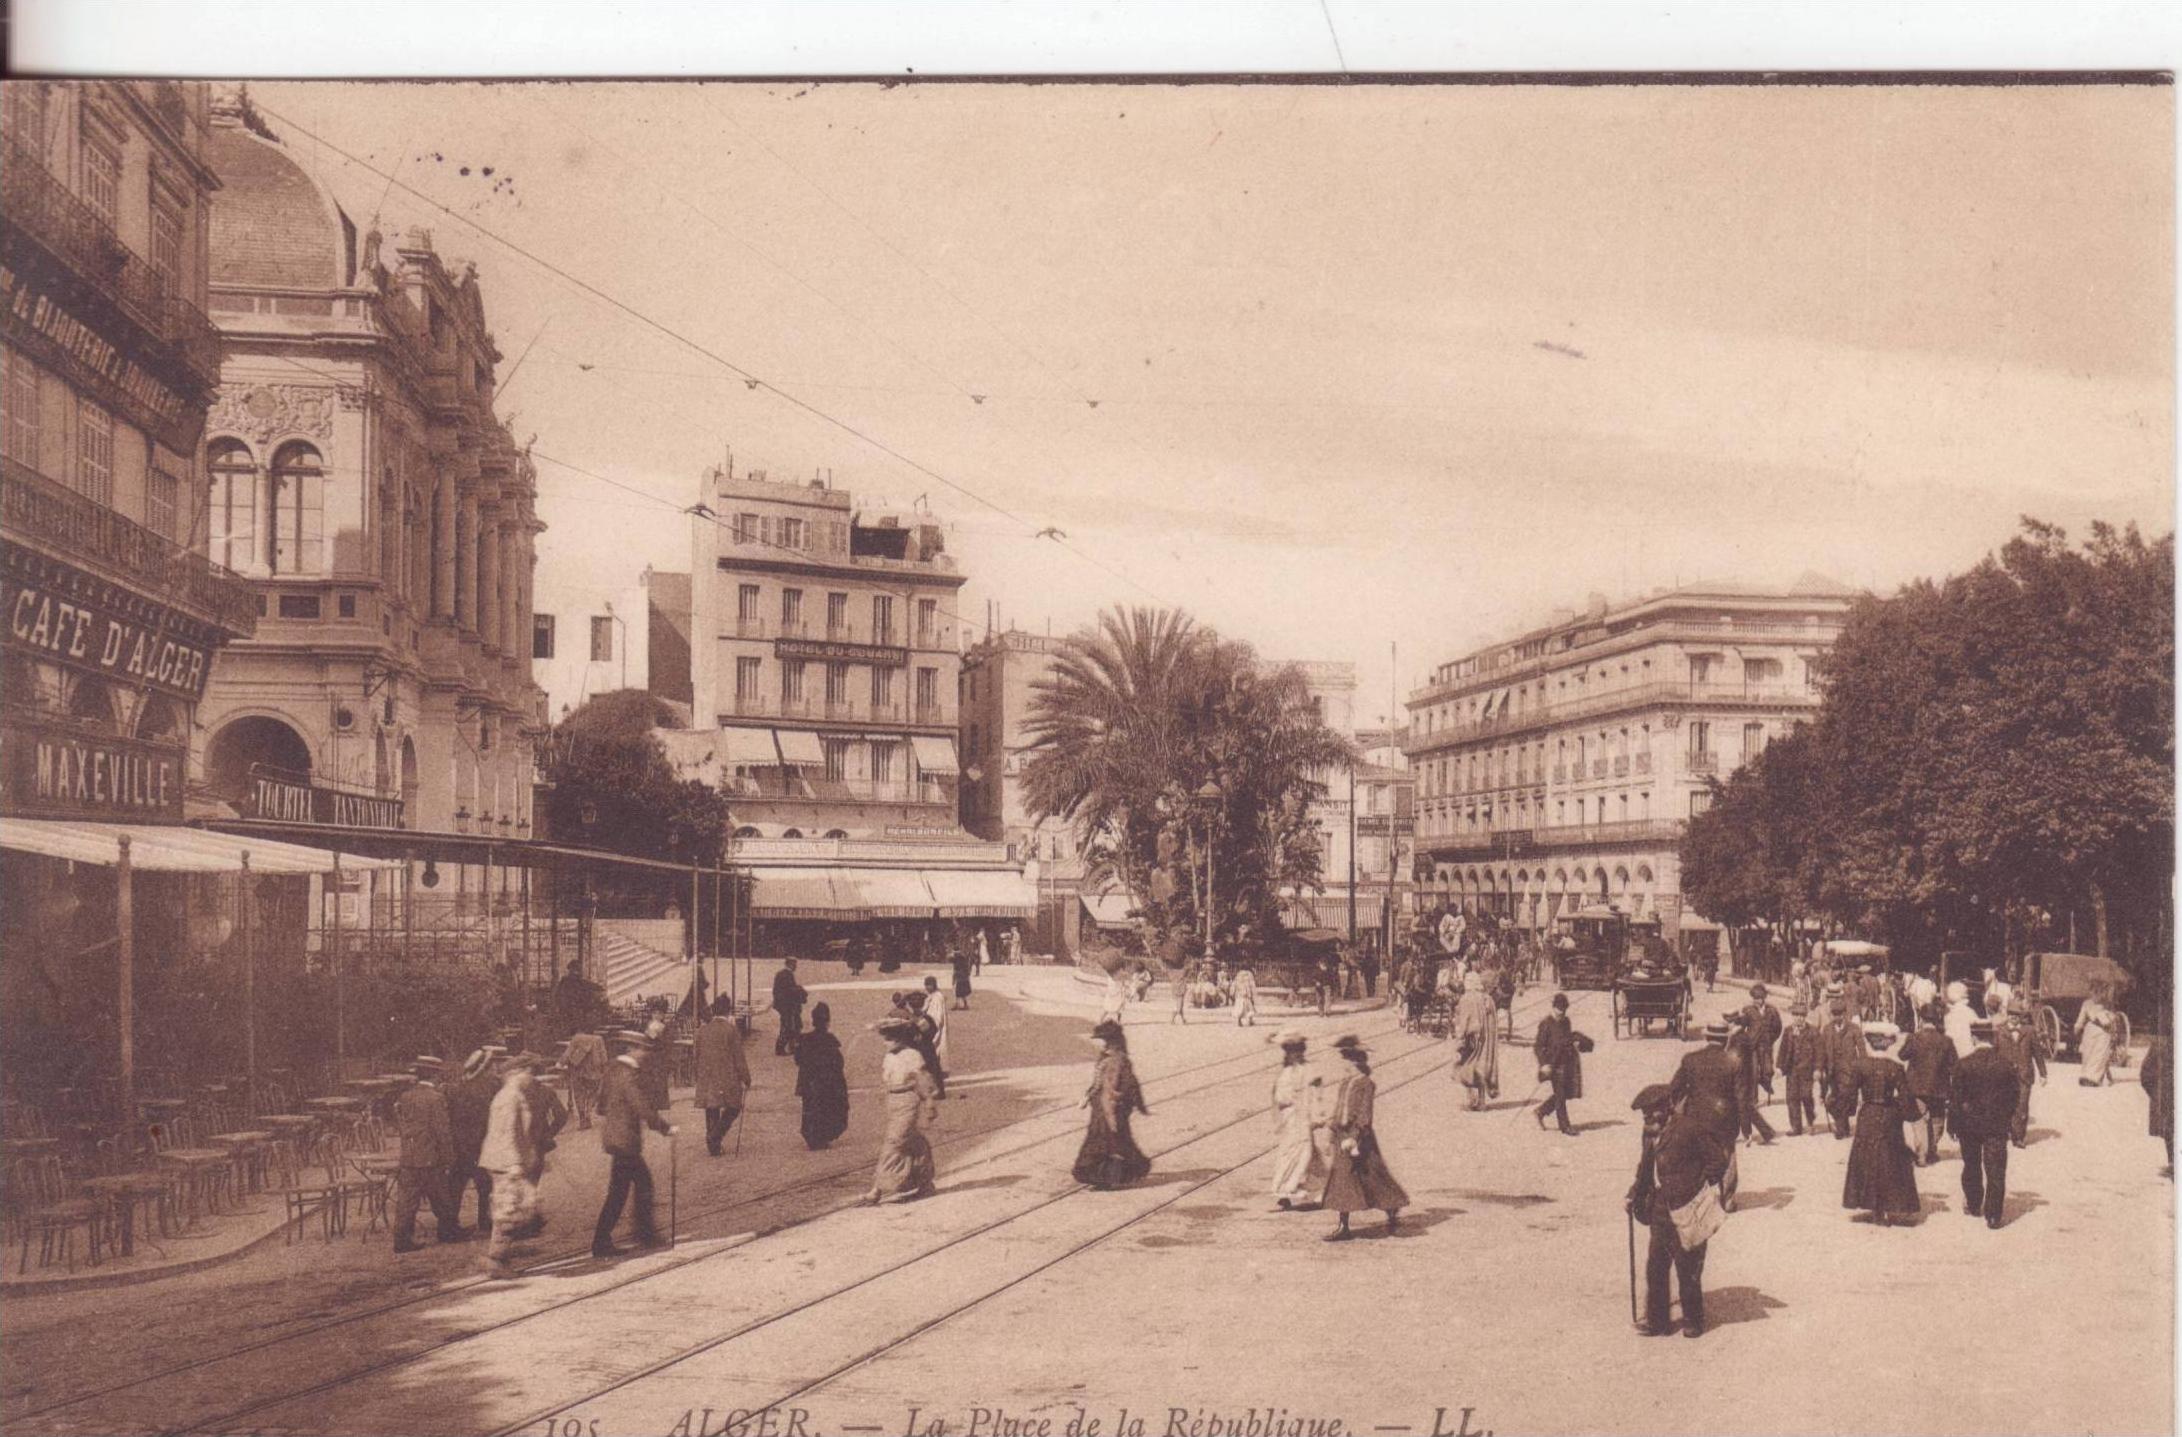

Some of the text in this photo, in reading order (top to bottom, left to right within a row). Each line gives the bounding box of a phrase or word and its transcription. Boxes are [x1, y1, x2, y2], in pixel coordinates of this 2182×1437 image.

[32, 294, 115, 376] BIJOUTERIE
[12, 589, 203, 692] CAFE D'ALGER
[36, 742, 171, 807] MAXEVILLE
